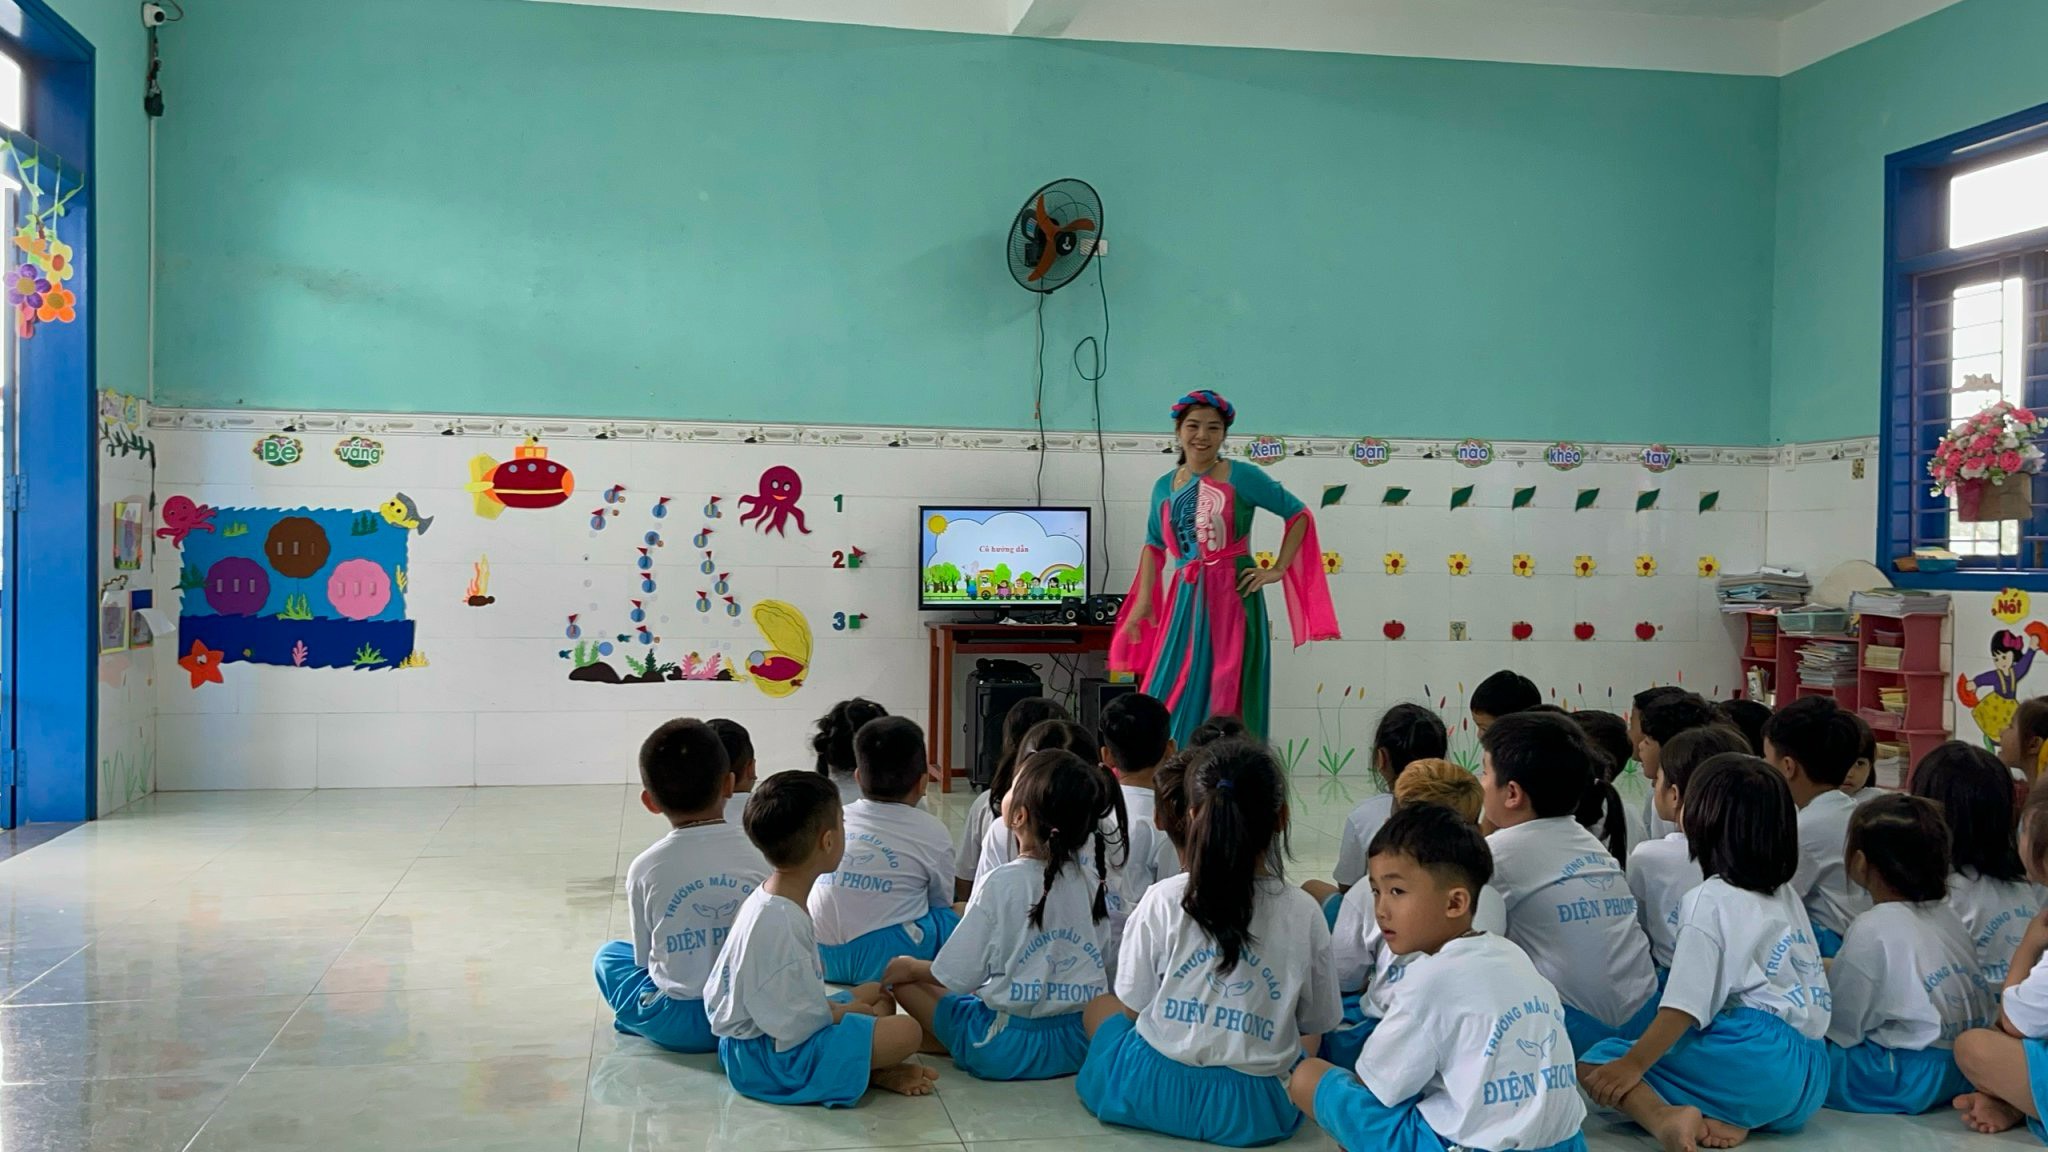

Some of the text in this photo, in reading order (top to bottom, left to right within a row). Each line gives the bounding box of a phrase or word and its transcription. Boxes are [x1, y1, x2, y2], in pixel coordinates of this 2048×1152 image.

[264, 440, 297, 461] Bé
[1251, 442, 1672, 467] Xem bạn nào khéo tay
[833, 494, 843, 512] 1
[832, 550, 845, 568] 2
[832, 611, 846, 631] 3
[840, 872, 893, 893] PHONG
[1557, 896, 1601, 925] ĐIỆN
[666, 928, 707, 955] ĐIỆN
[1261, 967, 1282, 1001] GIÁO
[1164, 997, 1274, 1042] ĐIỆN PHONG
[1483, 1071, 1537, 1108] ĐIỆN
